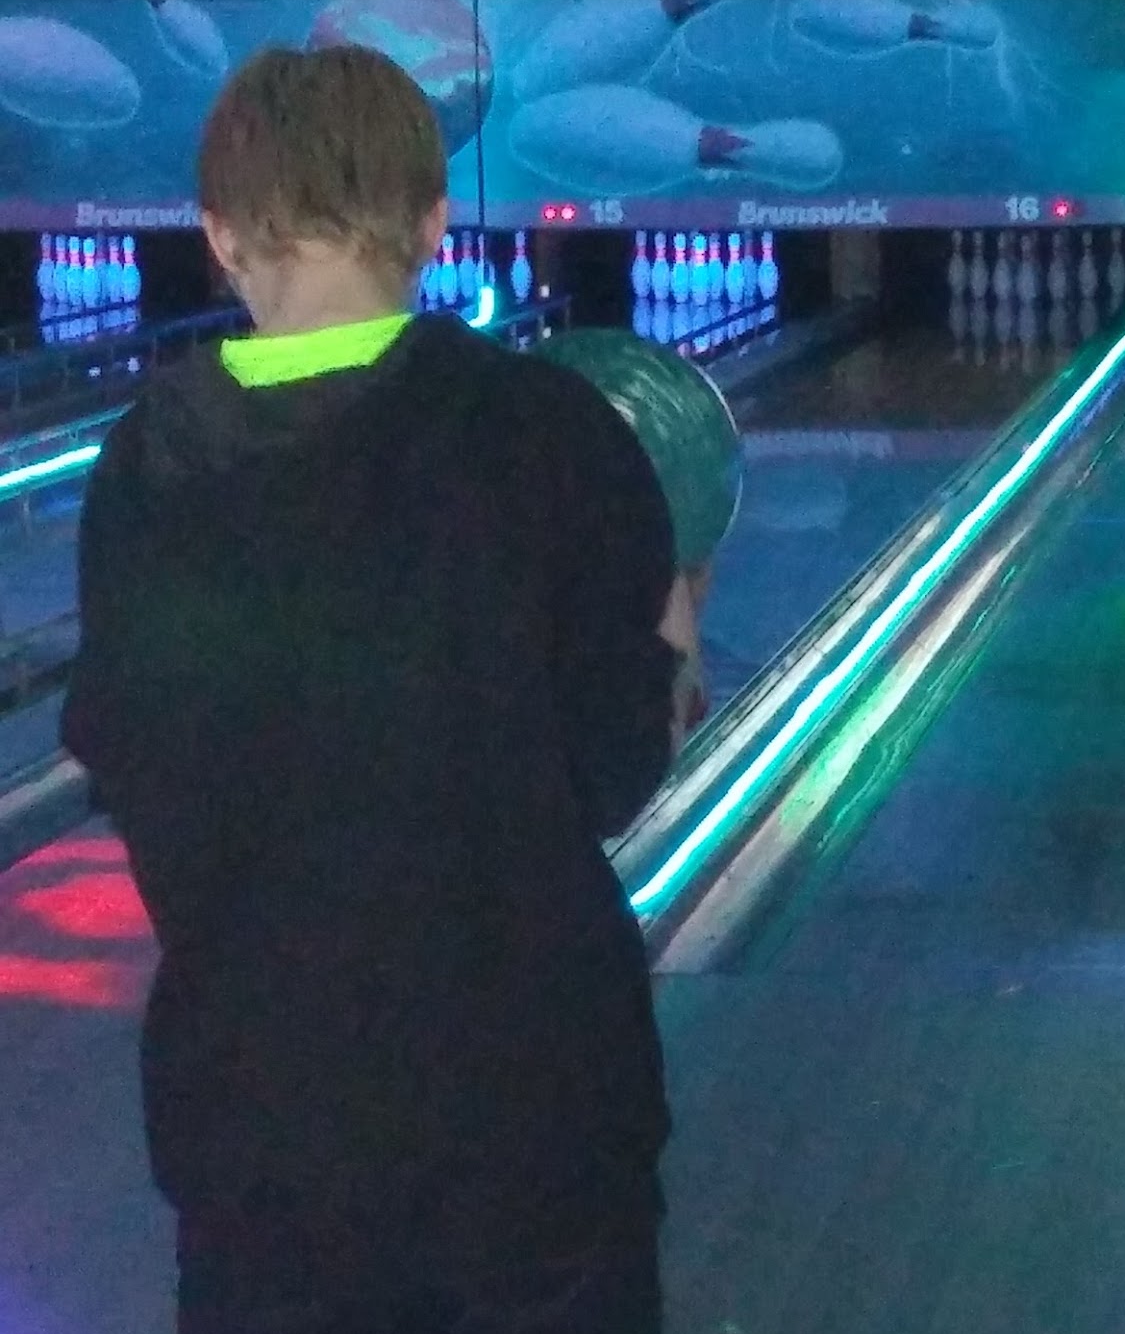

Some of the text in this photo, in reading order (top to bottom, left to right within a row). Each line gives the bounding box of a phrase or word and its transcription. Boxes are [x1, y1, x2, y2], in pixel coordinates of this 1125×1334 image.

[76, 201, 199, 227] Brunswi
[589, 198, 625, 225] 15
[738, 198, 888, 225] Brunswick
[1005, 196, 1039, 220] 16
